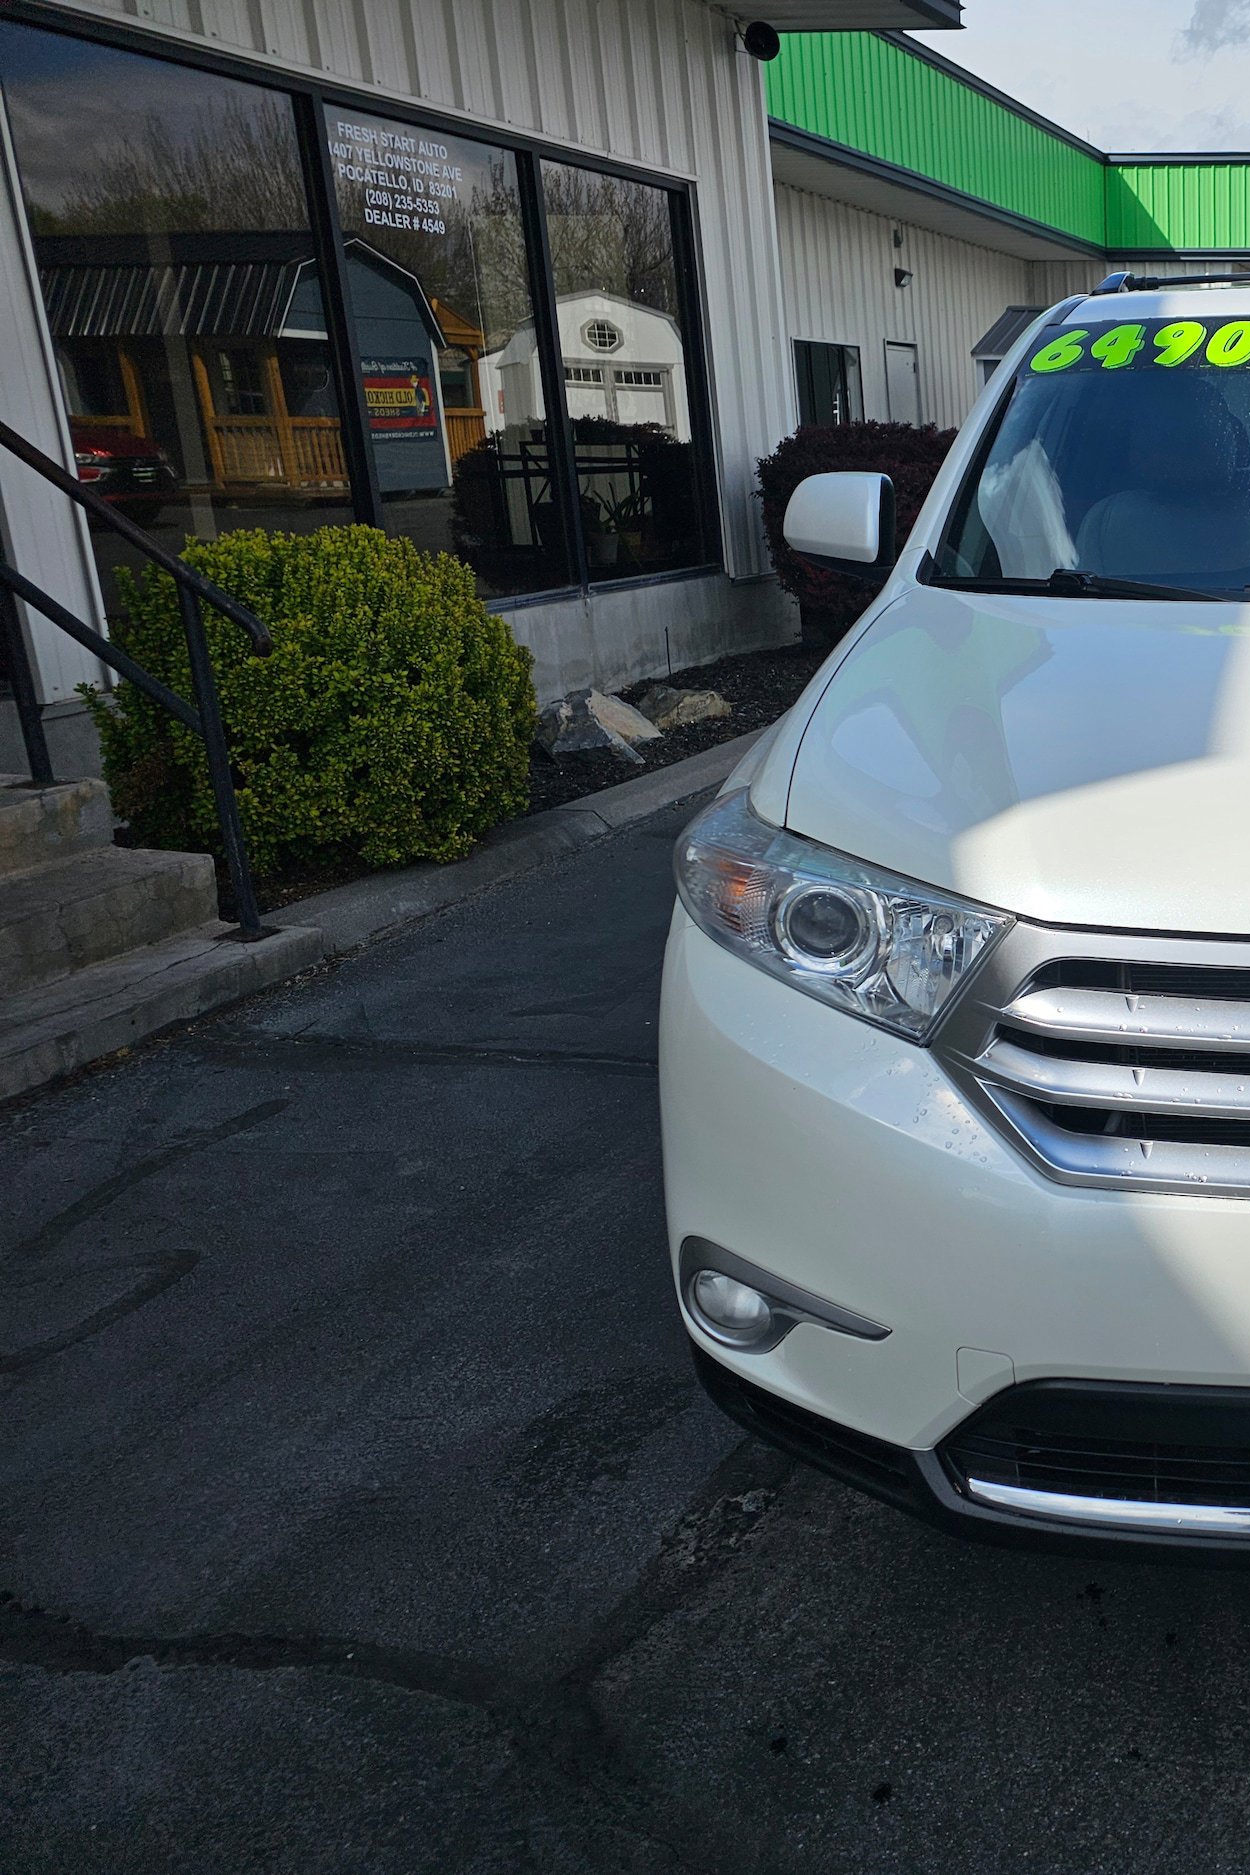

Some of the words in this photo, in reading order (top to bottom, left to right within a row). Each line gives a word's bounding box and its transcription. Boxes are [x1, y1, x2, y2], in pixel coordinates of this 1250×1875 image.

[337, 122, 377, 144] FRESH
[380, 132, 415, 152] START
[418, 140, 447, 159] AUTO
[328, 140, 353, 160] 1407
[355, 146, 440, 177] YELLOWSTONE
[442, 166, 463, 182] AVE
[338, 163, 412, 193] POCATELLO,
[412, 178, 424, 193] ID
[428, 182, 458, 199] 83201
[365, 188, 392, 210] (208)
[394, 194, 440, 215] 235-5353
[364, 208, 412, 230] DEALER
[412, 216, 420, 230] #
[421, 217, 446, 235] 4549
